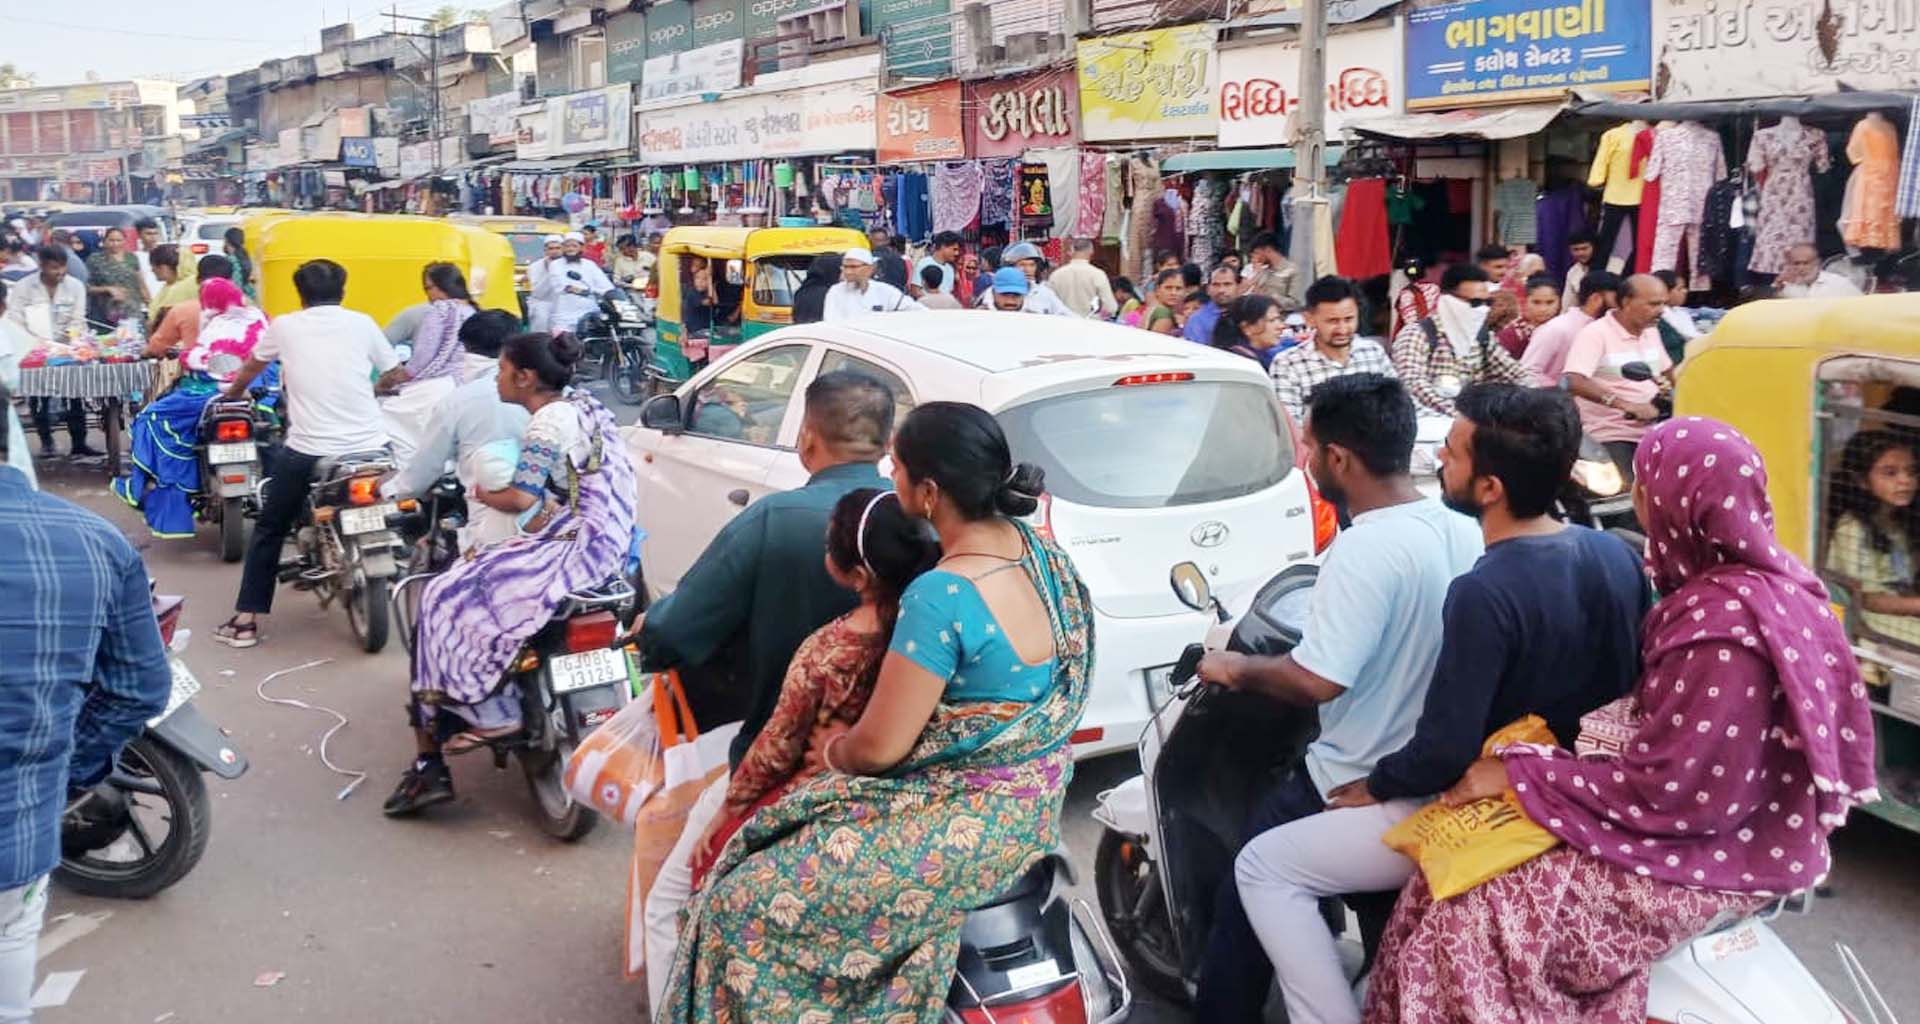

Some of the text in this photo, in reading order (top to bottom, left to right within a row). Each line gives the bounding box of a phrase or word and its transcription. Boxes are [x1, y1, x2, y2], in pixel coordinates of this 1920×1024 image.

[694, 10, 735, 30] oppo
[651, 24, 685, 43] oppo
[981, 86, 1071, 141] કમલા
[568, 665, 615, 688] J3129
